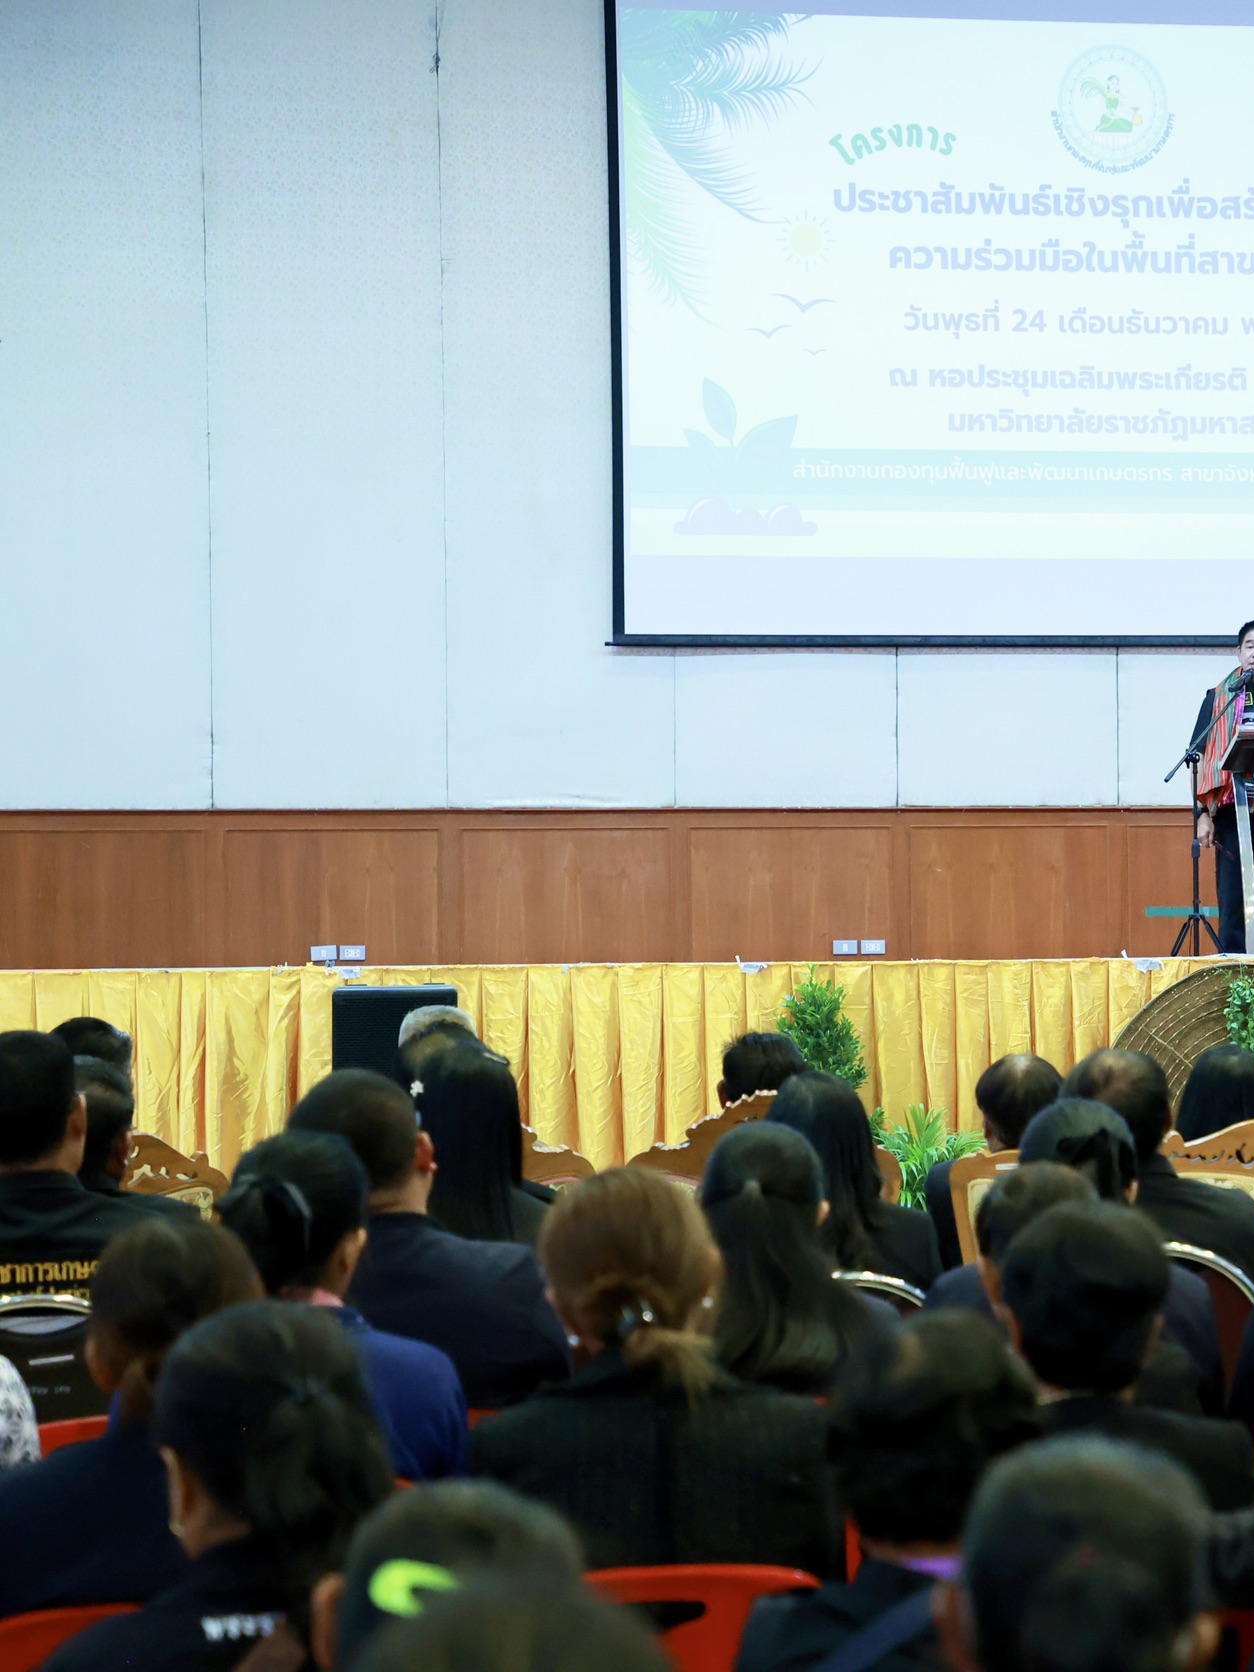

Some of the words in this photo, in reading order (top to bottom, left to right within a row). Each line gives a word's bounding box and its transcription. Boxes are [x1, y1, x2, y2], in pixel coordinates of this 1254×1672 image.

[828, 123, 957, 166] โครงการ
[903, 299, 1000, 340] วันพุธที่
[1011, 309, 1048, 333] 24
[1058, 307, 1229, 335] เดือนธันวาคม
[888, 367, 918, 388] ณ
[928, 363, 1248, 398] หอประชุมเฉลิมพระเกียรติ
[792, 455, 1173, 486] สำนักงานกองทุนฟื้นฟูและพัฒนาเกษตรกร
[0, 1260, 98, 1284] ชาการเกษ
